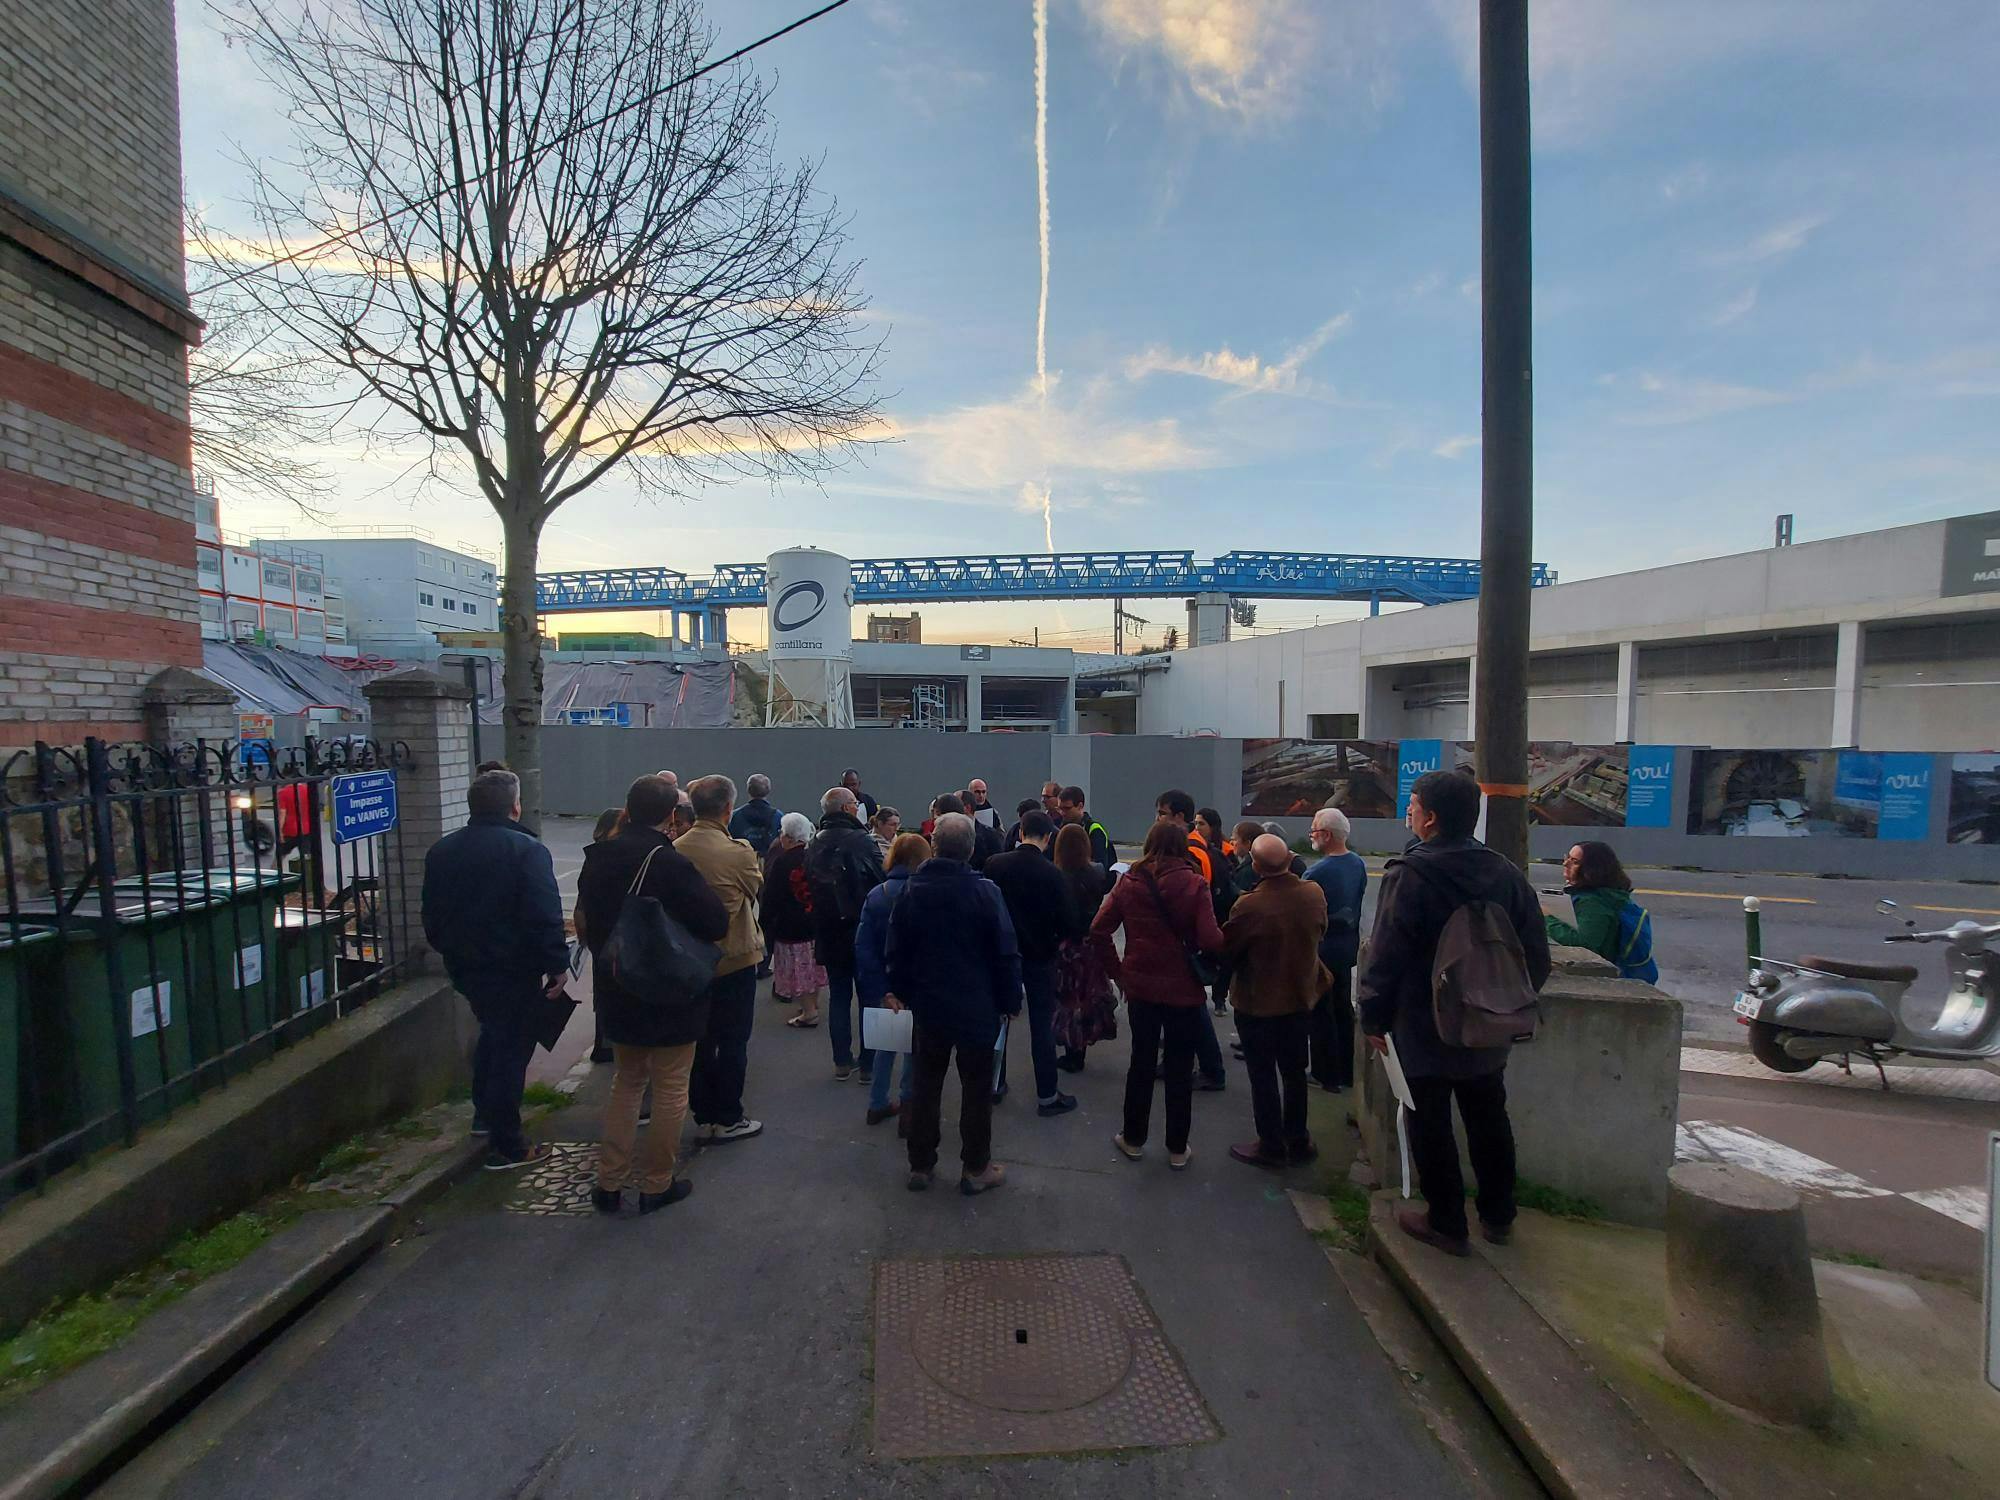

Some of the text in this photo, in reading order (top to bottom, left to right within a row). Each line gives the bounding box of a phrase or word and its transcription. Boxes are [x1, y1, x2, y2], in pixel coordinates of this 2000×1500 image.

[775, 640, 823, 650] cantillana
[350, 795, 383, 809] Impasse
[344, 806, 389, 826] De VANVES
